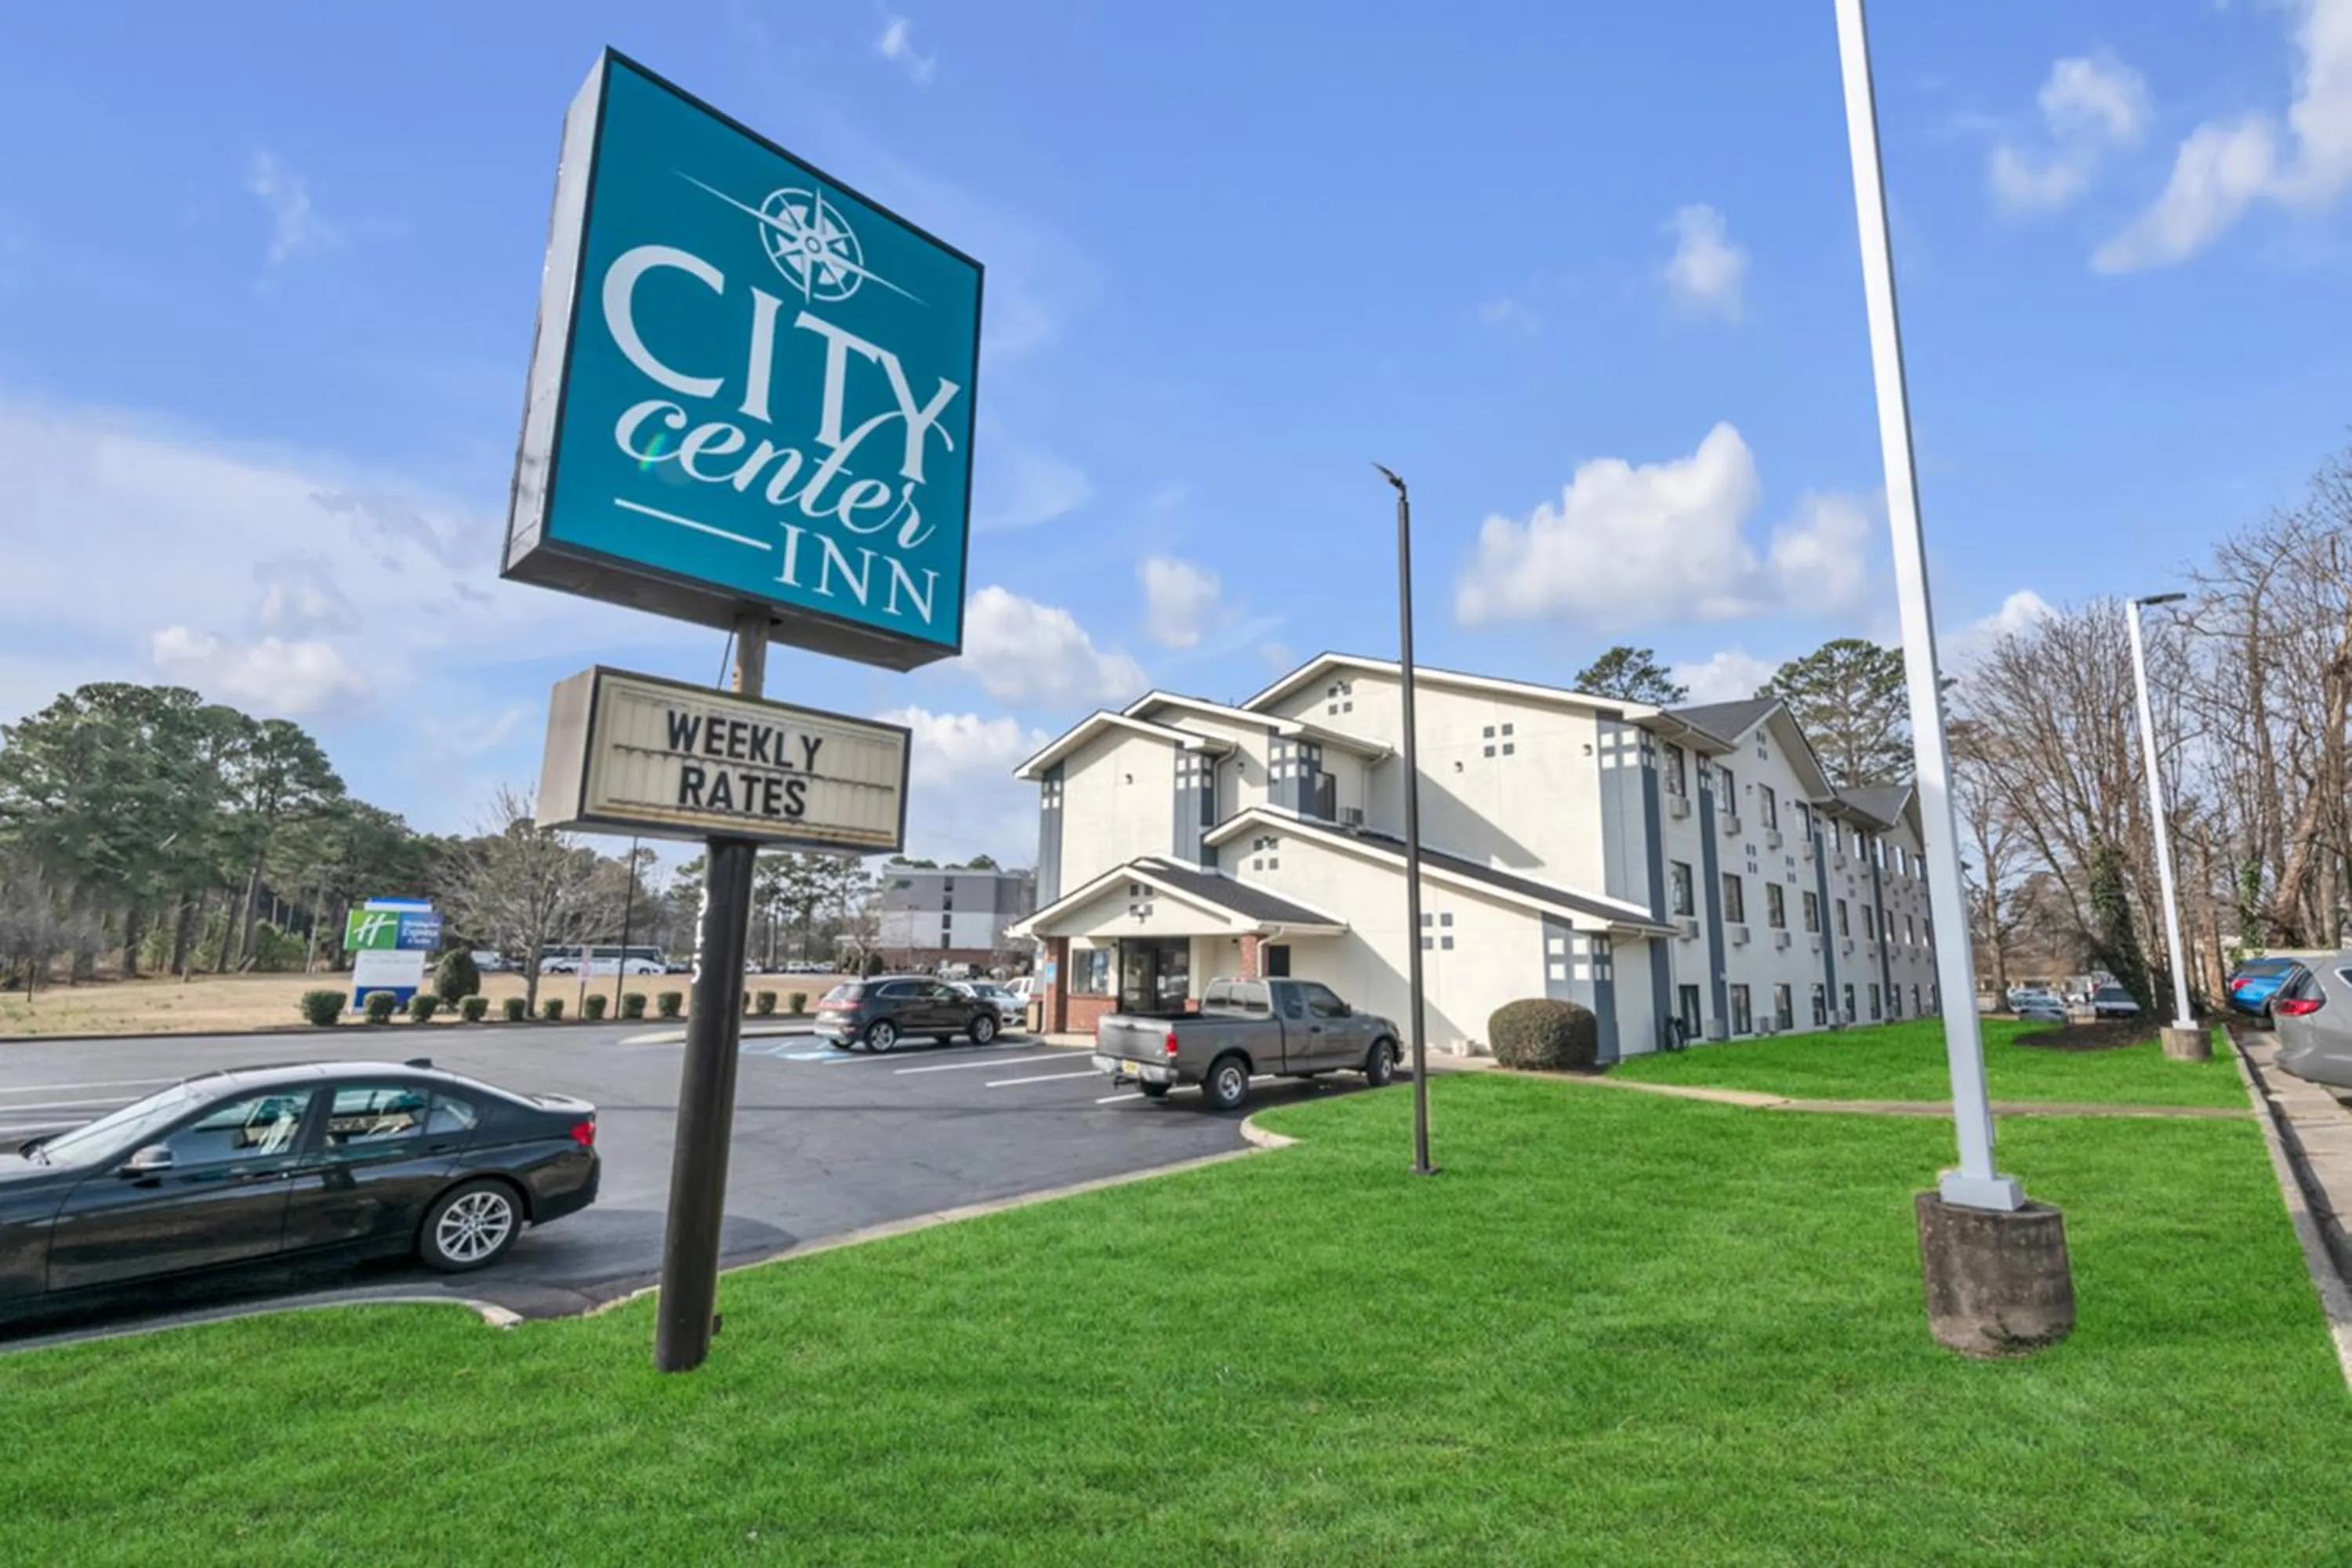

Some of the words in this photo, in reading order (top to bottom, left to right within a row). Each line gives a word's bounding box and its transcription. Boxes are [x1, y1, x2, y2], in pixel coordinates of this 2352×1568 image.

[601, 244, 960, 483] CITY
[615, 399, 937, 549] center
[775, 521, 941, 624] INN
[666, 710, 822, 771] WEEKLY
[678, 765, 807, 818] RATES
